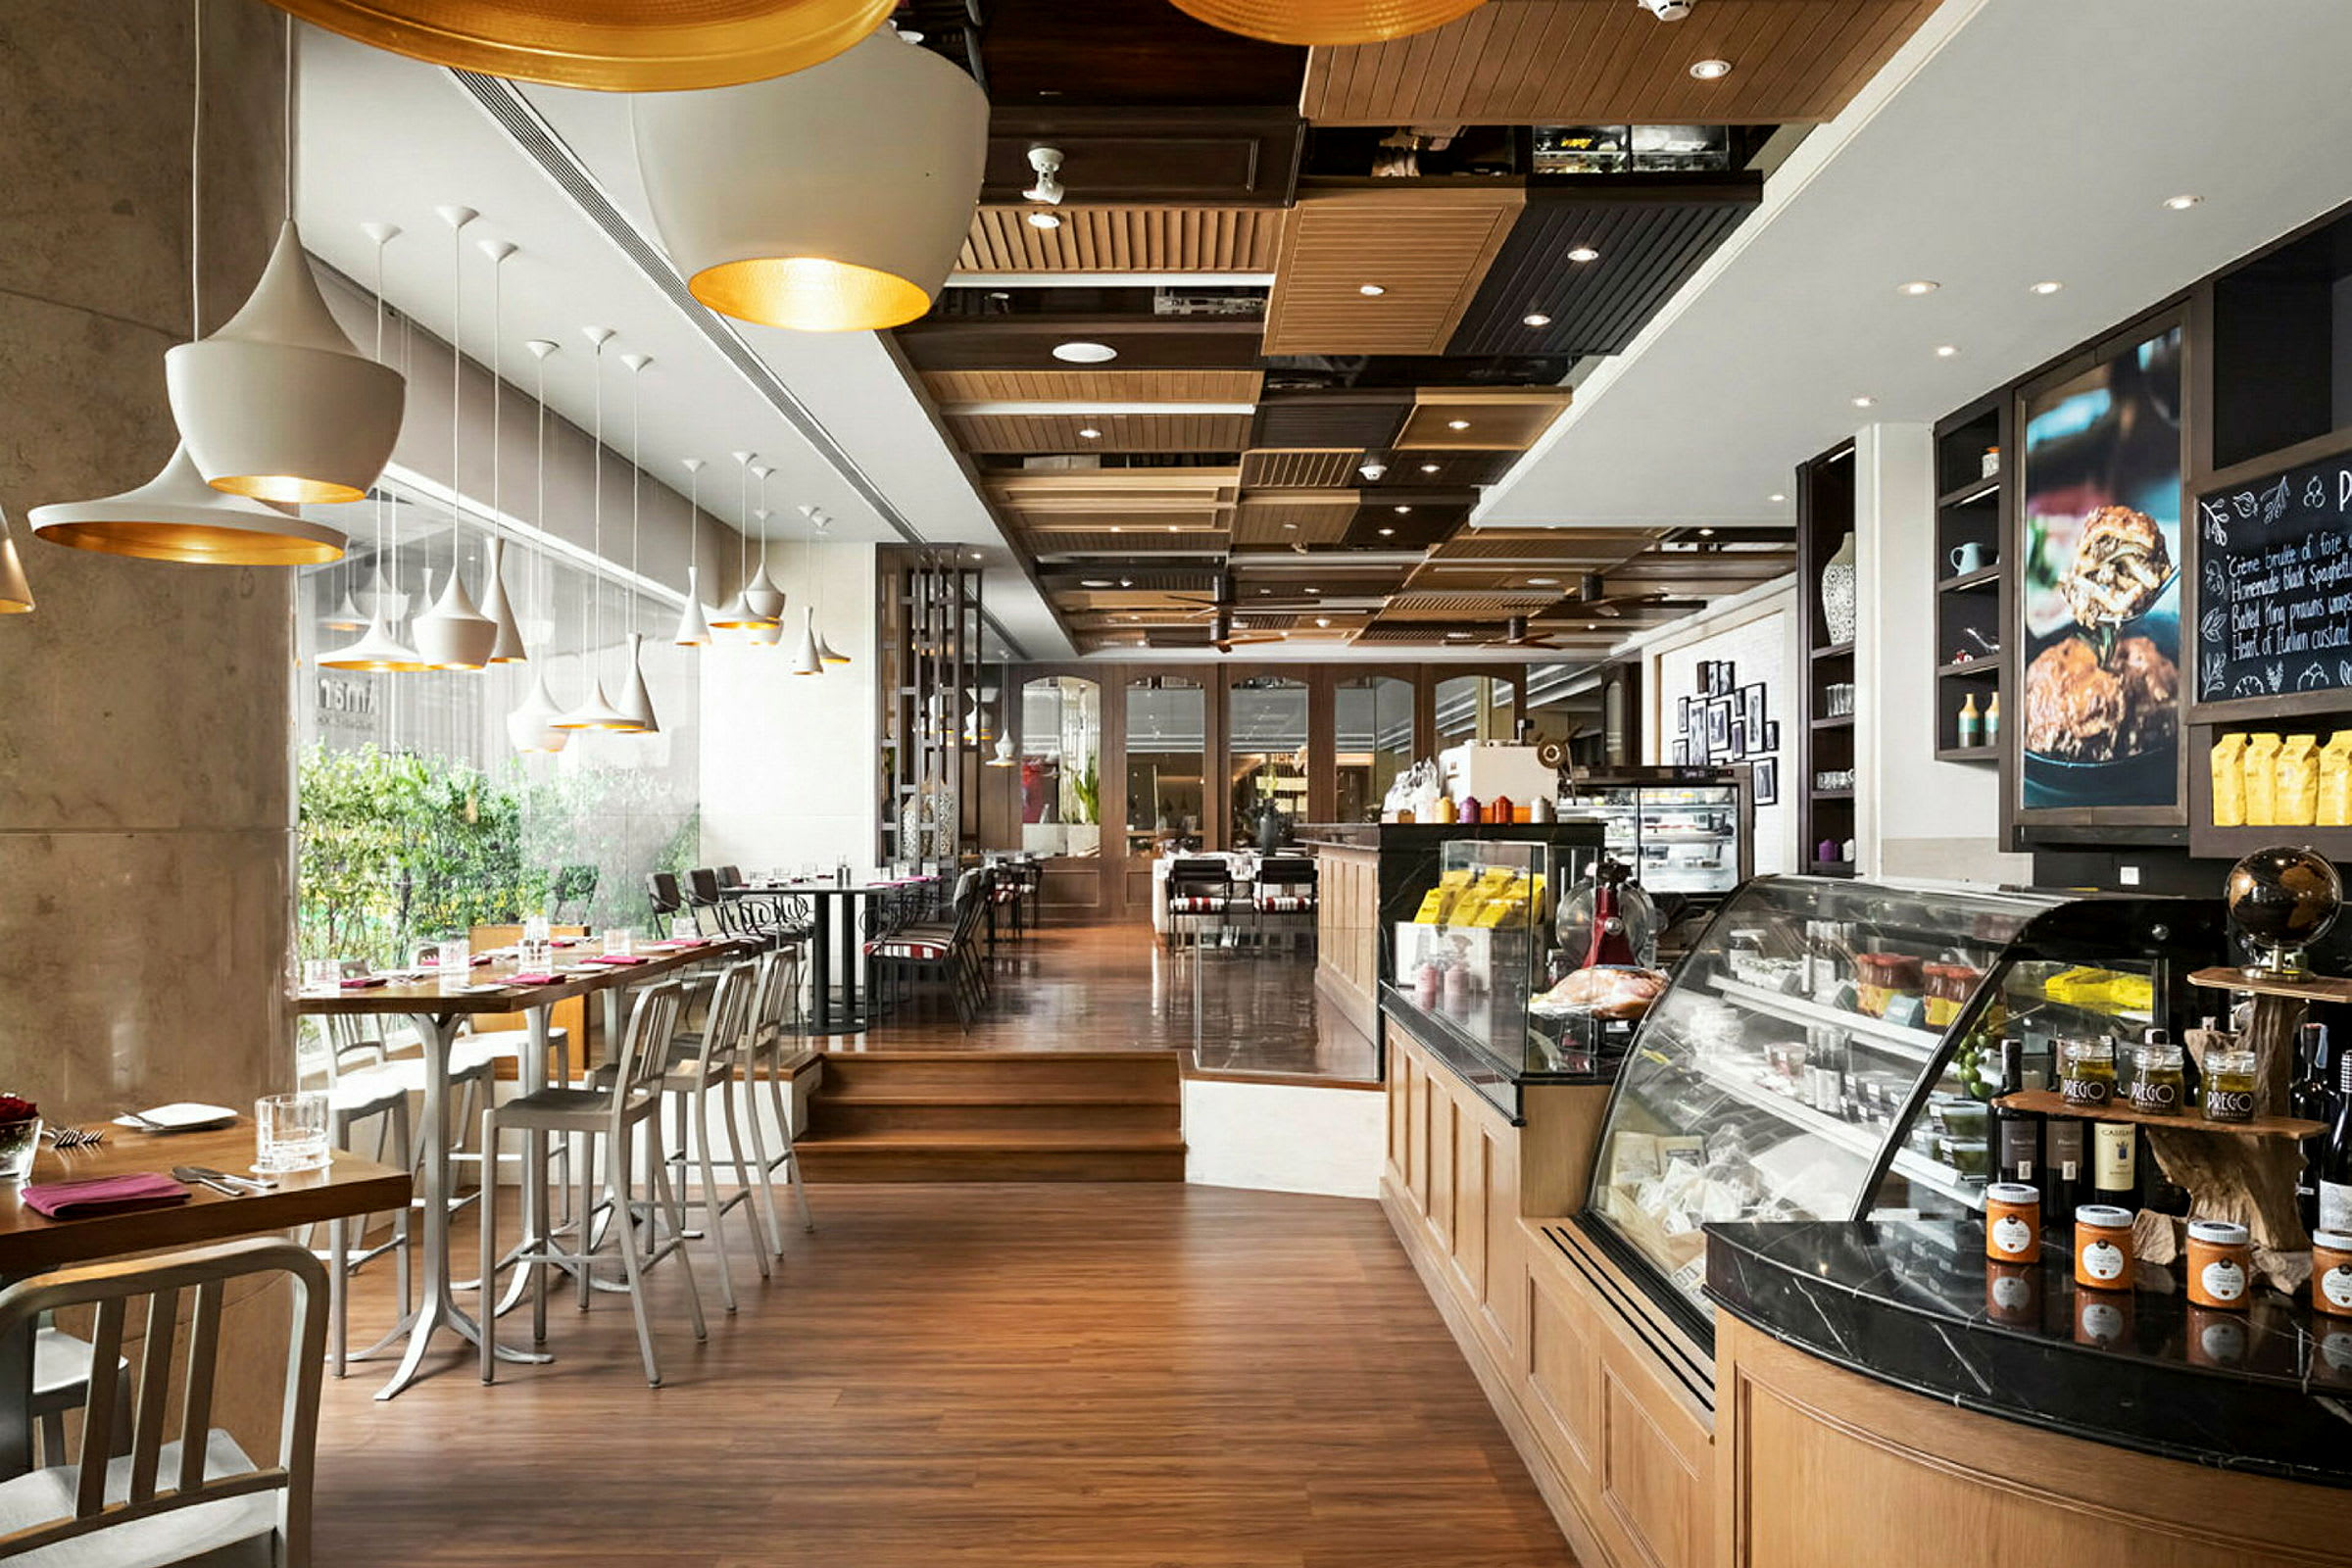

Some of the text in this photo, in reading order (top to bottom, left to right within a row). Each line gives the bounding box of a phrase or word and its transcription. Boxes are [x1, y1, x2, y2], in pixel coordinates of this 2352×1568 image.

[2320, 530, 2342, 556] foie
[2262, 626, 2275, 656] of
[2063, 1079, 2106, 1100] PREGO
[2131, 1081, 2176, 1103] PREGO
[2207, 1091, 2253, 1112] PREGO
